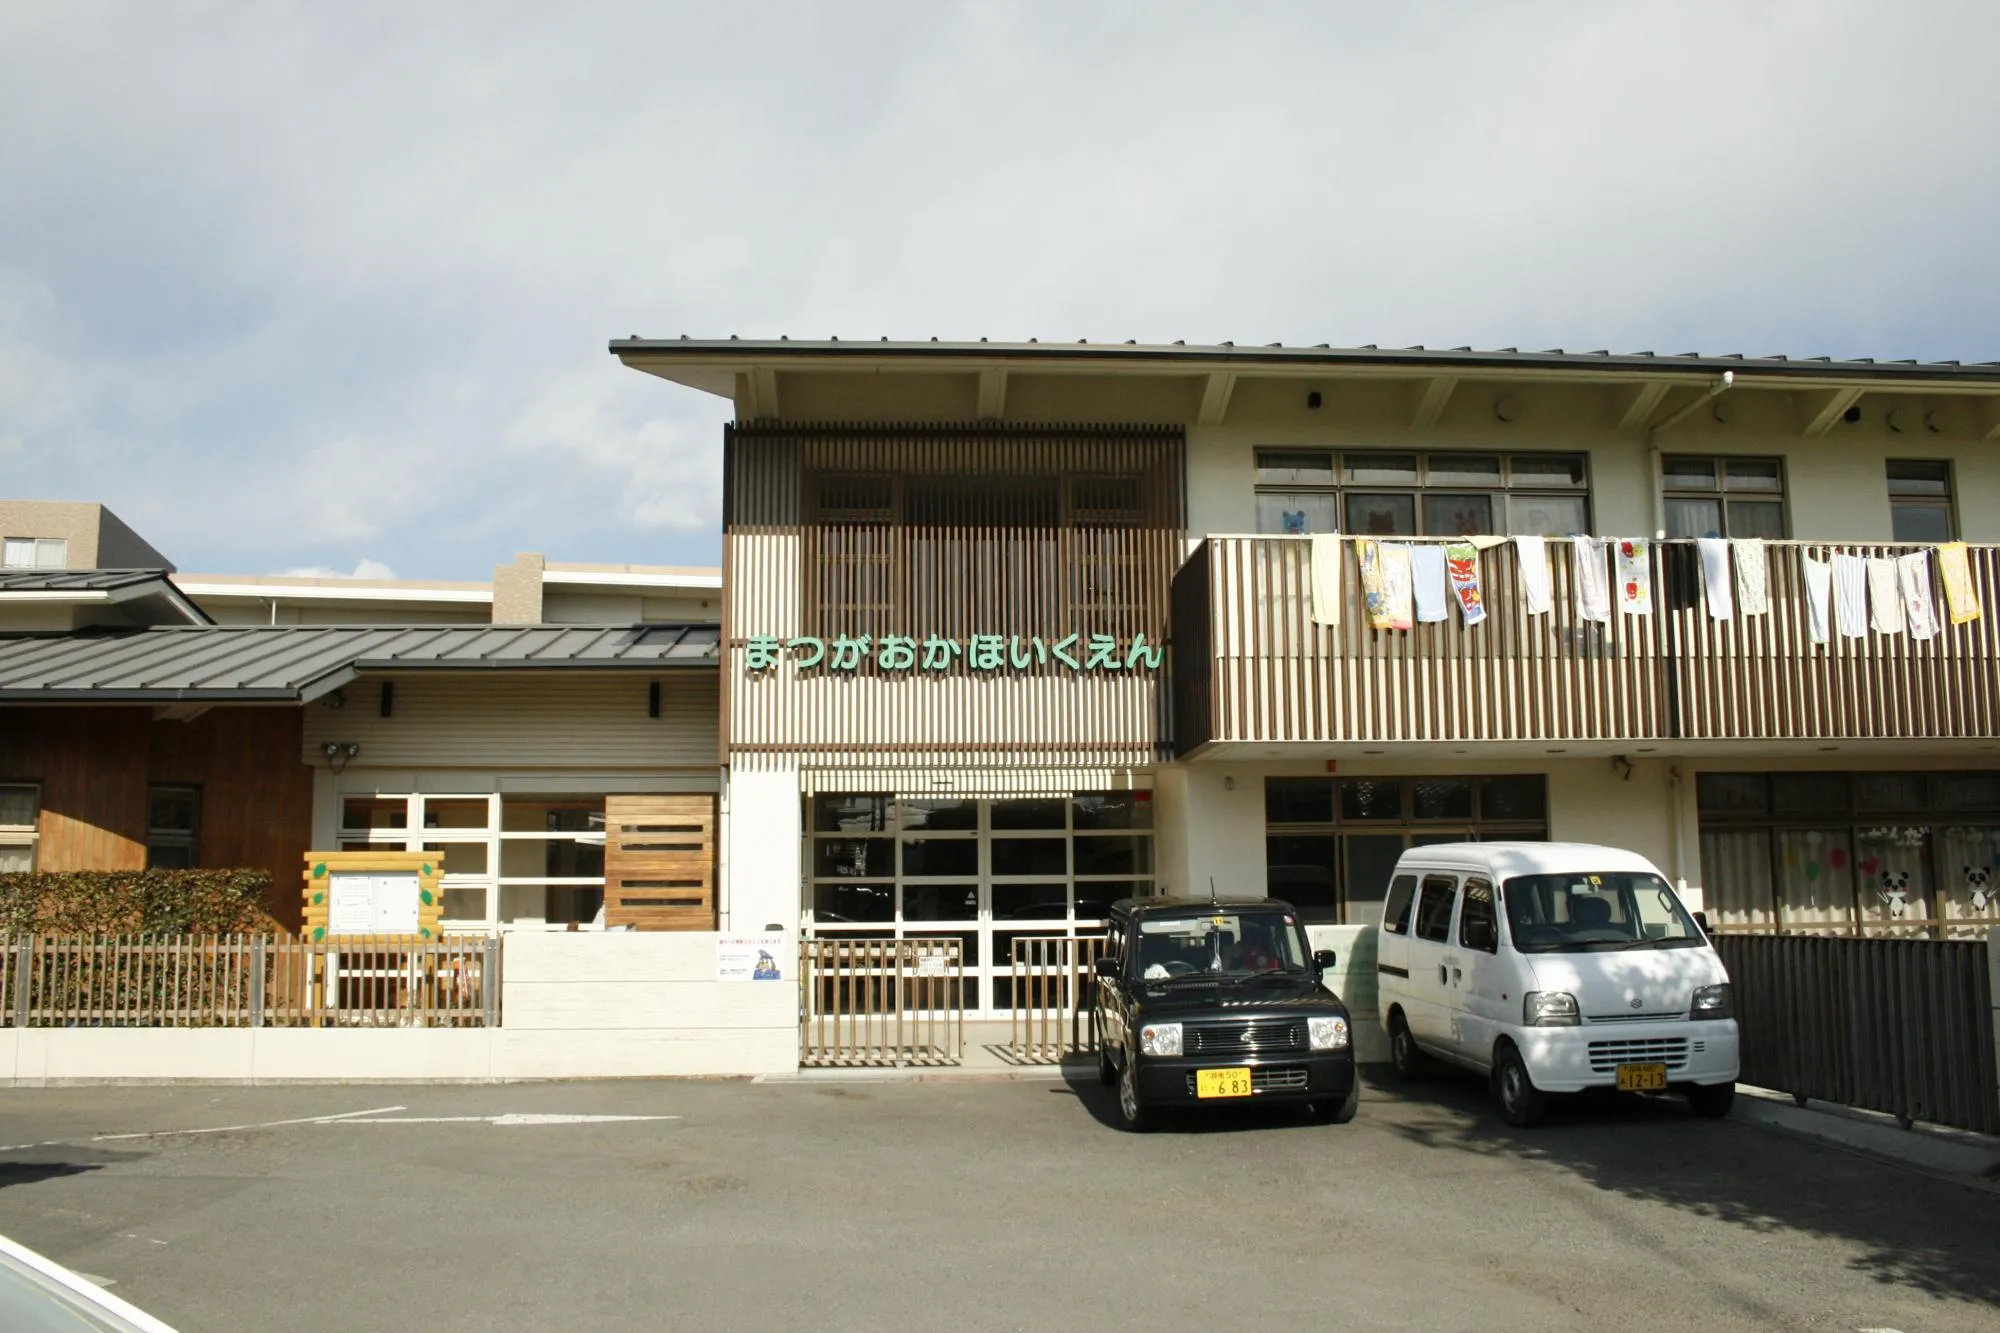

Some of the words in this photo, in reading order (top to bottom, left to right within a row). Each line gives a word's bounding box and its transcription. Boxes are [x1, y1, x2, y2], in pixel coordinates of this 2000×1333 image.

[745, 632, 1165, 671] まつがおかほいくえん
